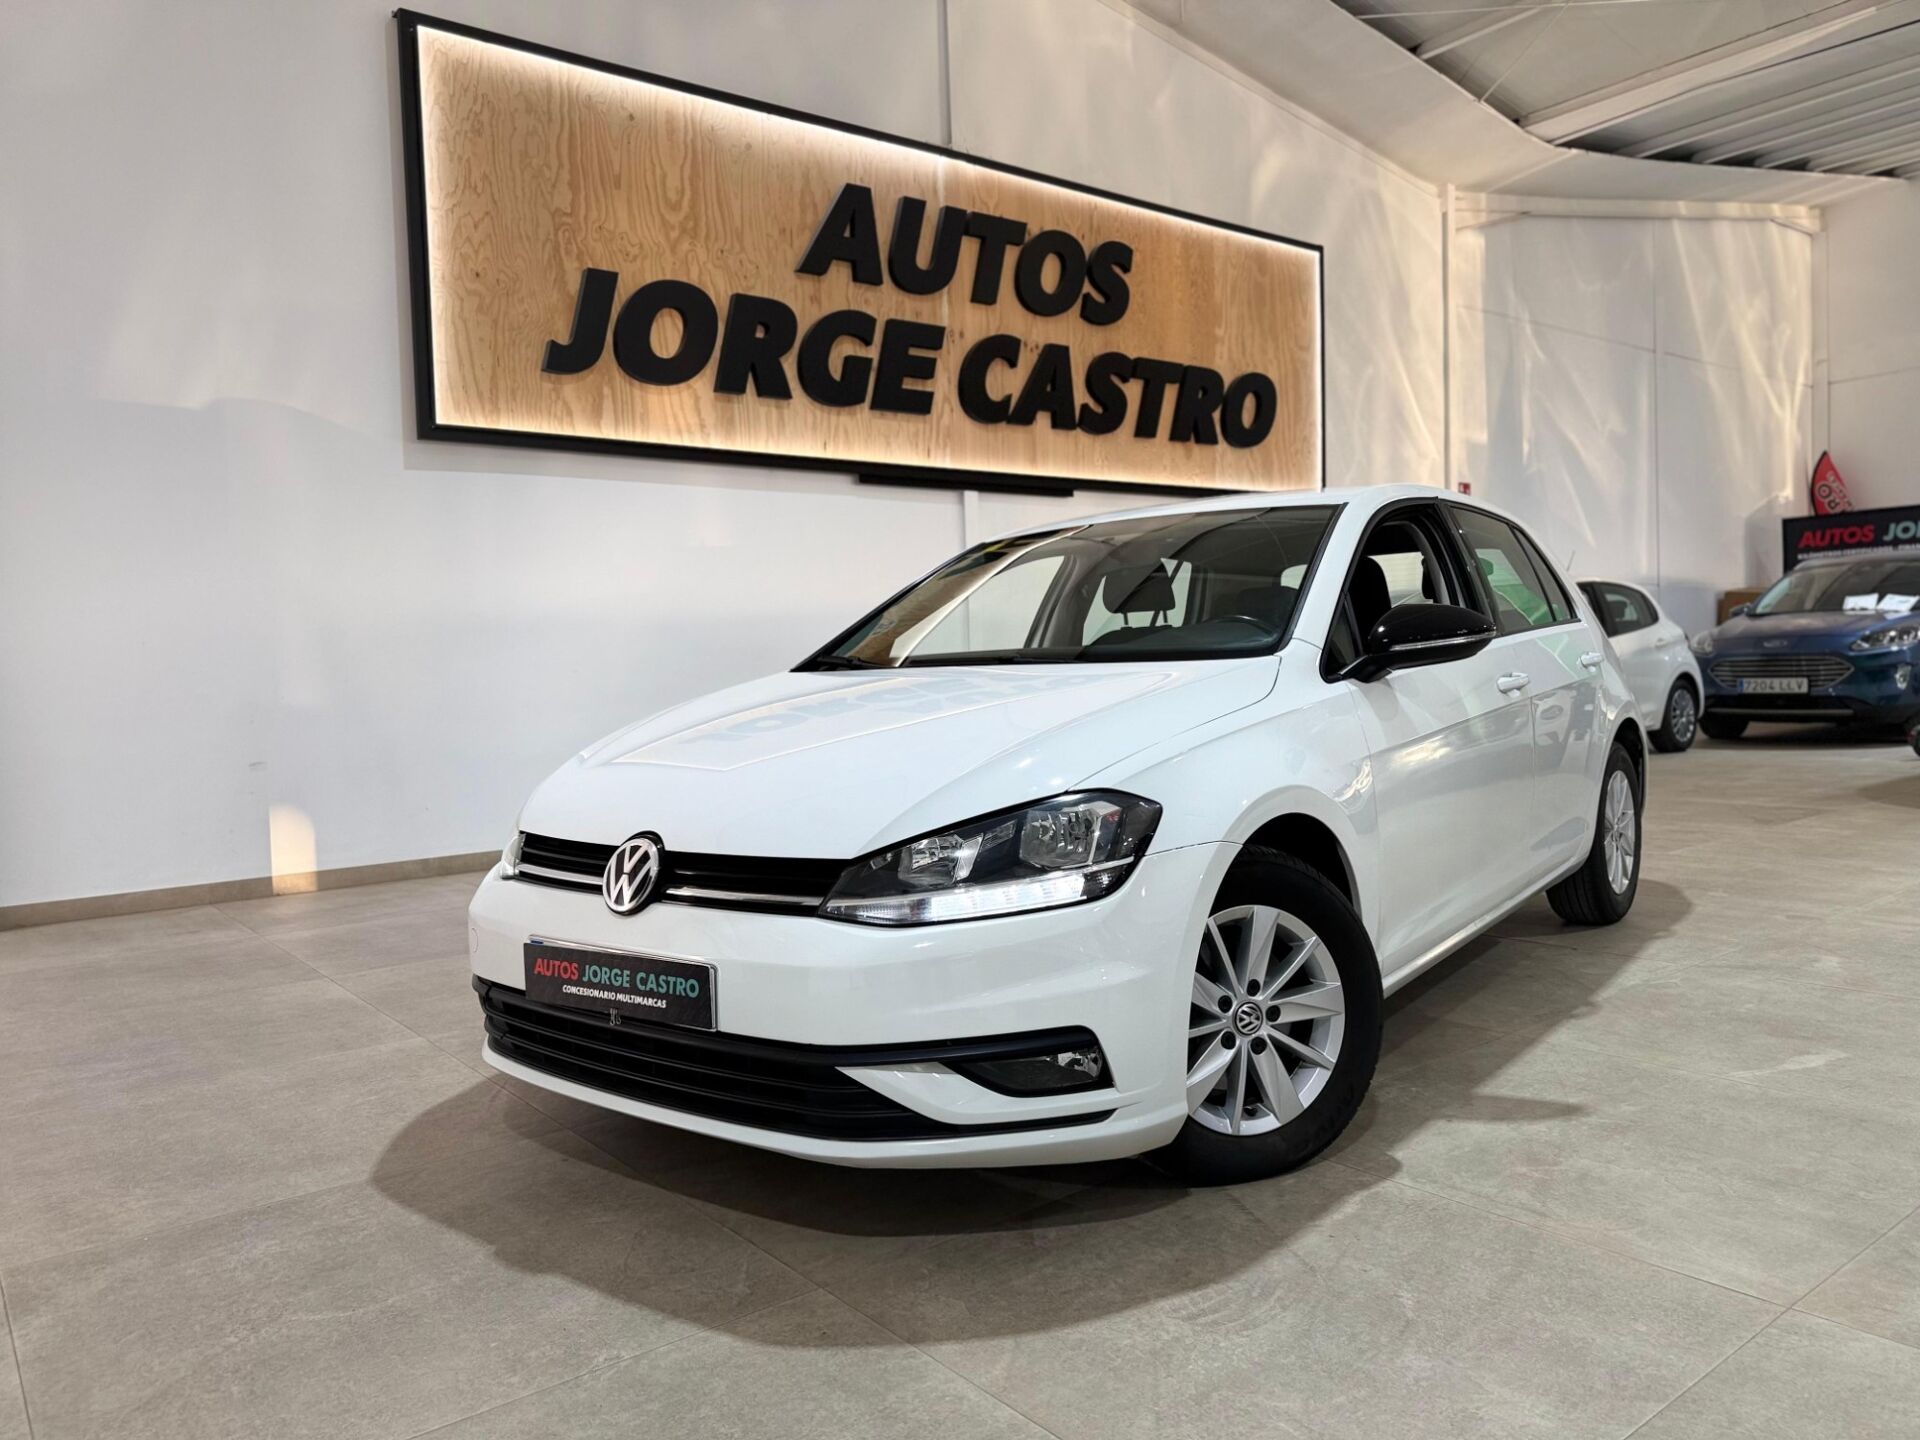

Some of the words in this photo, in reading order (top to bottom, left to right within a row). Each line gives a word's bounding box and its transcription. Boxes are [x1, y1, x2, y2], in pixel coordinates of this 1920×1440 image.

[794, 182, 1134, 326] AUTOS
[541, 267, 946, 415] JORGE
[957, 334, 1277, 448] CASTRO
[1797, 524, 1875, 549] AUTOS
[1882, 521, 1920, 542] JO
[603, 838, 659, 912] VW
[534, 958, 580, 981] AUTOS
[582, 964, 631, 988] JORGE
[636, 972, 700, 998] CASTRO
[562, 984, 616, 1001] CONCESIONARIO
[616, 992, 667, 1009] MULTIMARCAS
